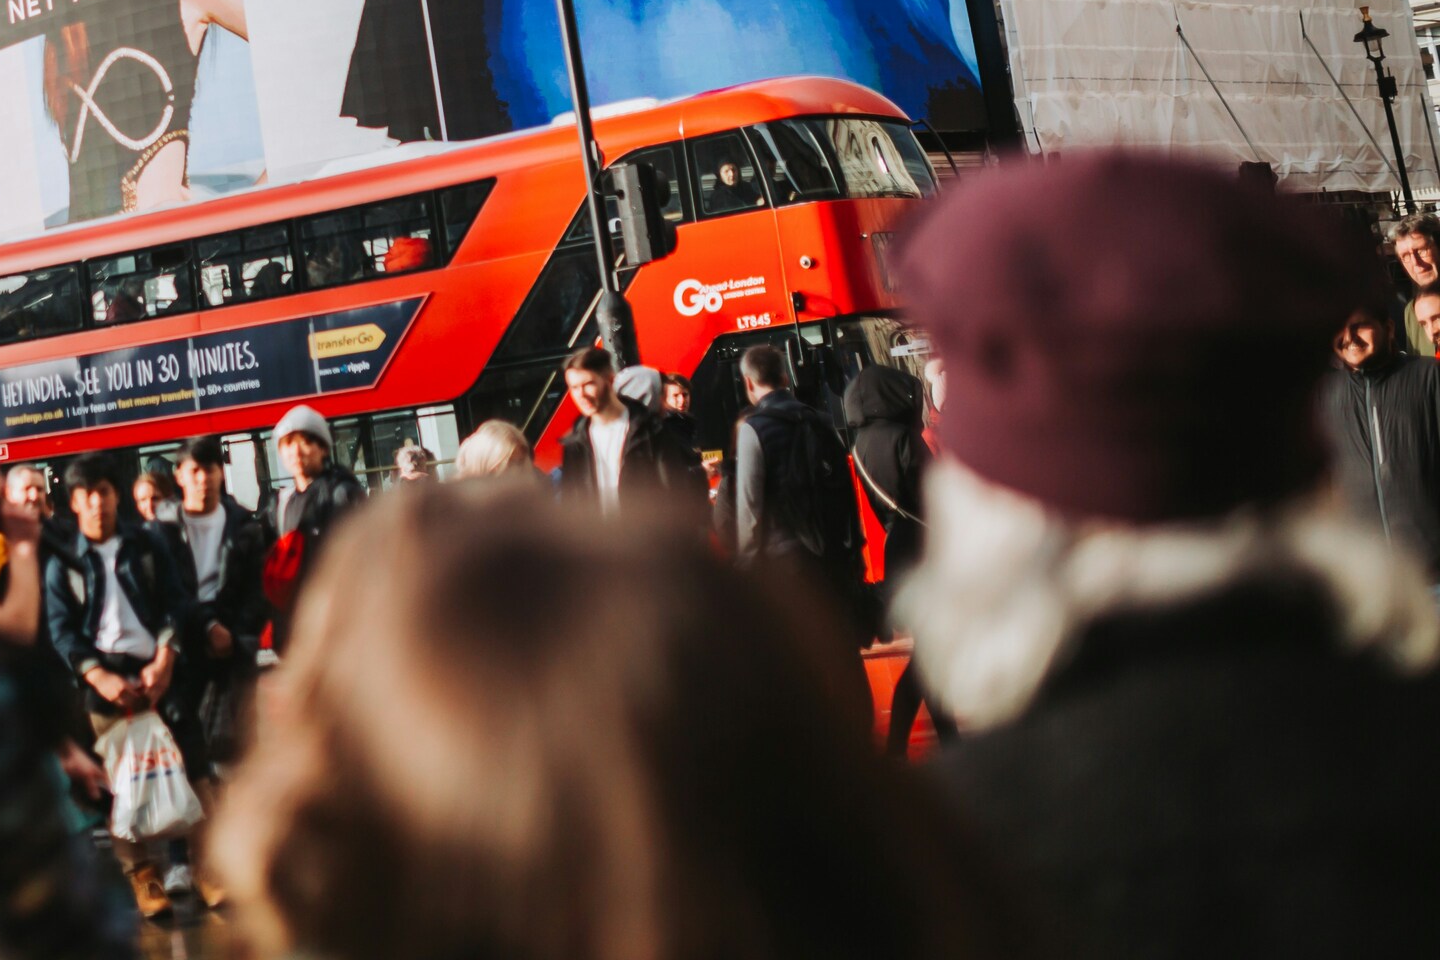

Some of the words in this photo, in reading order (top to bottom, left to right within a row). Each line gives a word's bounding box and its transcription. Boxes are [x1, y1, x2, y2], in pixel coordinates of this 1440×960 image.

[673, 278, 723, 317] Go
[736, 312, 772, 330] LT845
[1, 379, 24, 408] HEY
[26, 373, 72, 405] INDIA.
[74, 366, 102, 398] SEE
[104, 361, 134, 392] YOU
[135, 359, 154, 387] IN
[157, 353, 180, 383] 30
[186, 340, 260, 379] MINUTES.
[346, 360, 371, 374] ripple
[72, 405, 90, 417] Low
[90, 401, 107, 414] fees
[106, 399, 118, 411] on
[117, 397, 134, 410] fast
[134, 394, 161, 407] money
[206, 383, 223, 395] 50+
[223, 378, 261, 394] countries
